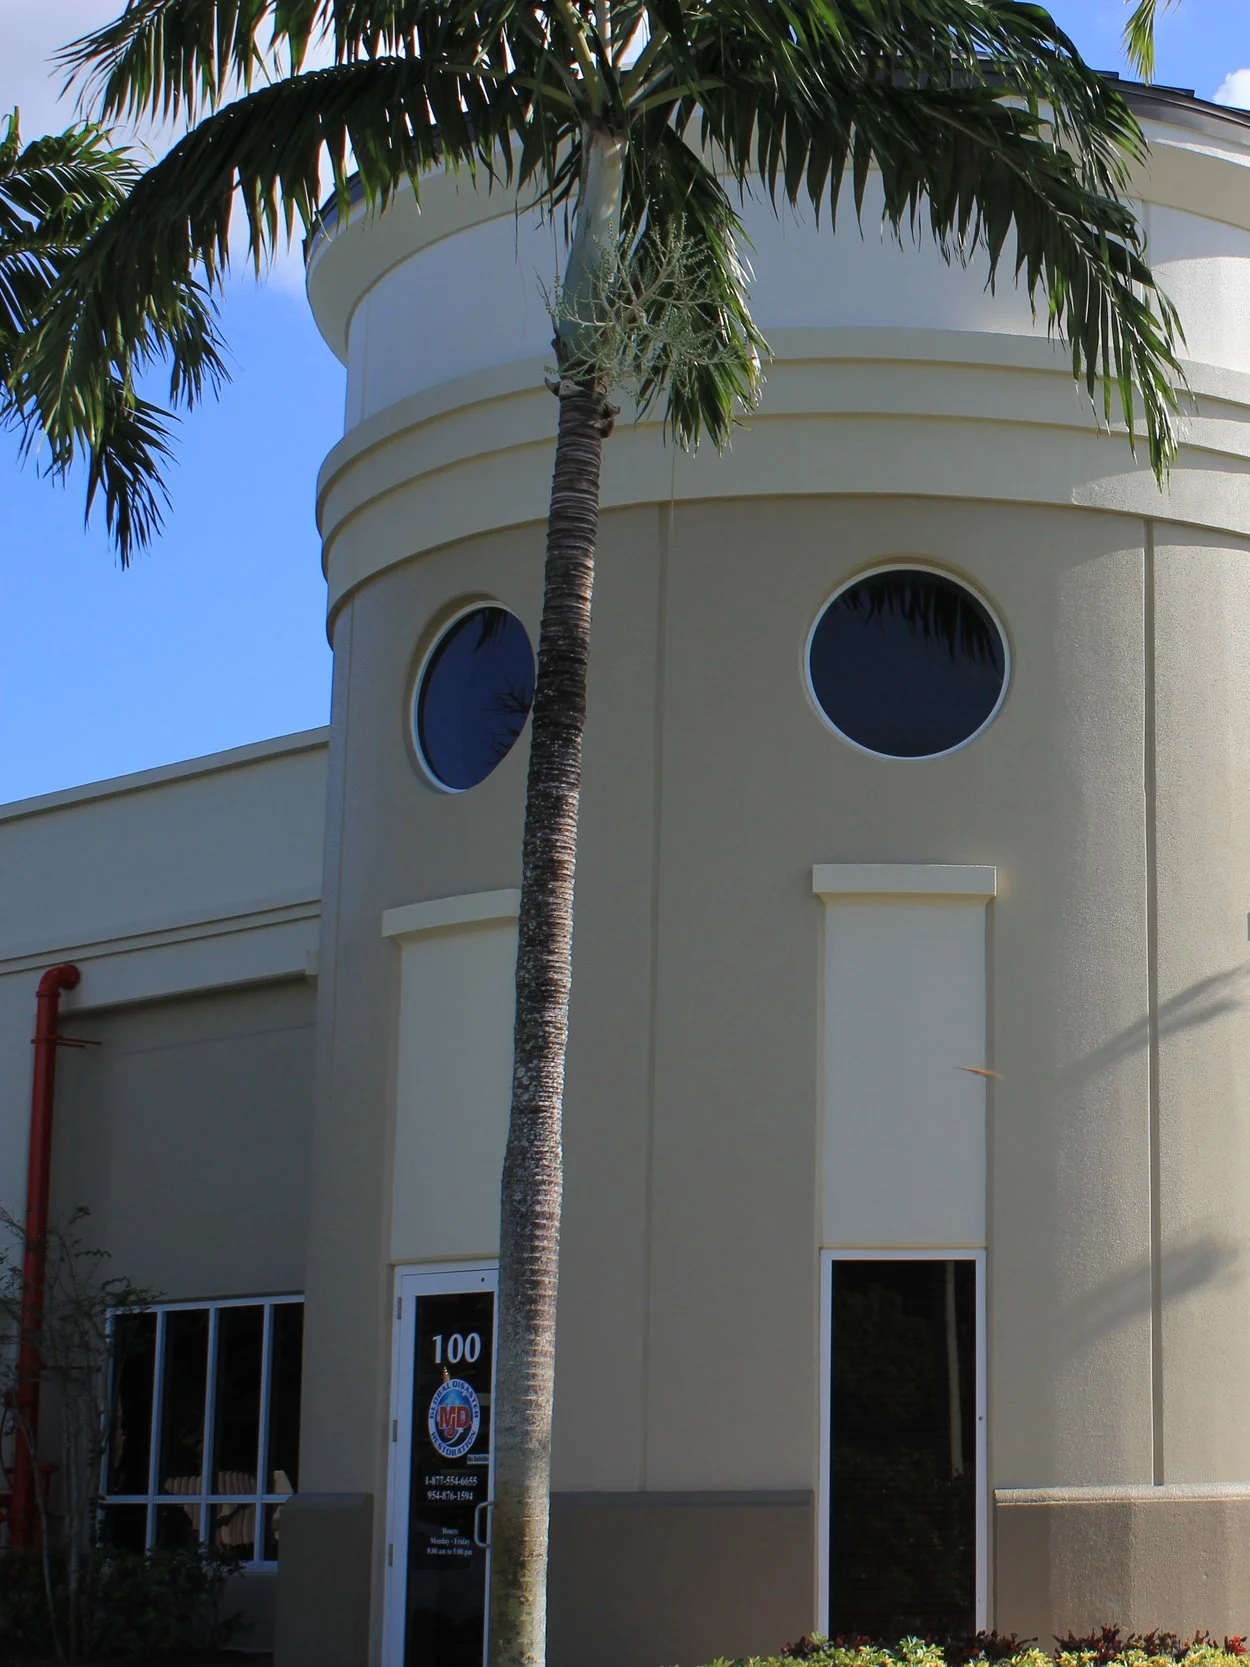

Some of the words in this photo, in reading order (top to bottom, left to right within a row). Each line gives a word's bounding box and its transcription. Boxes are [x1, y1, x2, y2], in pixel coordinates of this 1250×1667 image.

[432, 1333, 481, 1364] 100
[430, 1383, 450, 1419] GLOBAL
[452, 1381, 479, 1418] DISASTER
[431, 1430, 477, 1456] RESTORATION
[425, 1475, 478, 1487] 1-877-554-6655
[427, 1490, 473, 1500] 954-876-1594
[442, 1527, 459, 1535] Hours:
[430, 1537, 450, 1546] Monday
[454, 1537, 470, 1545] Friday
